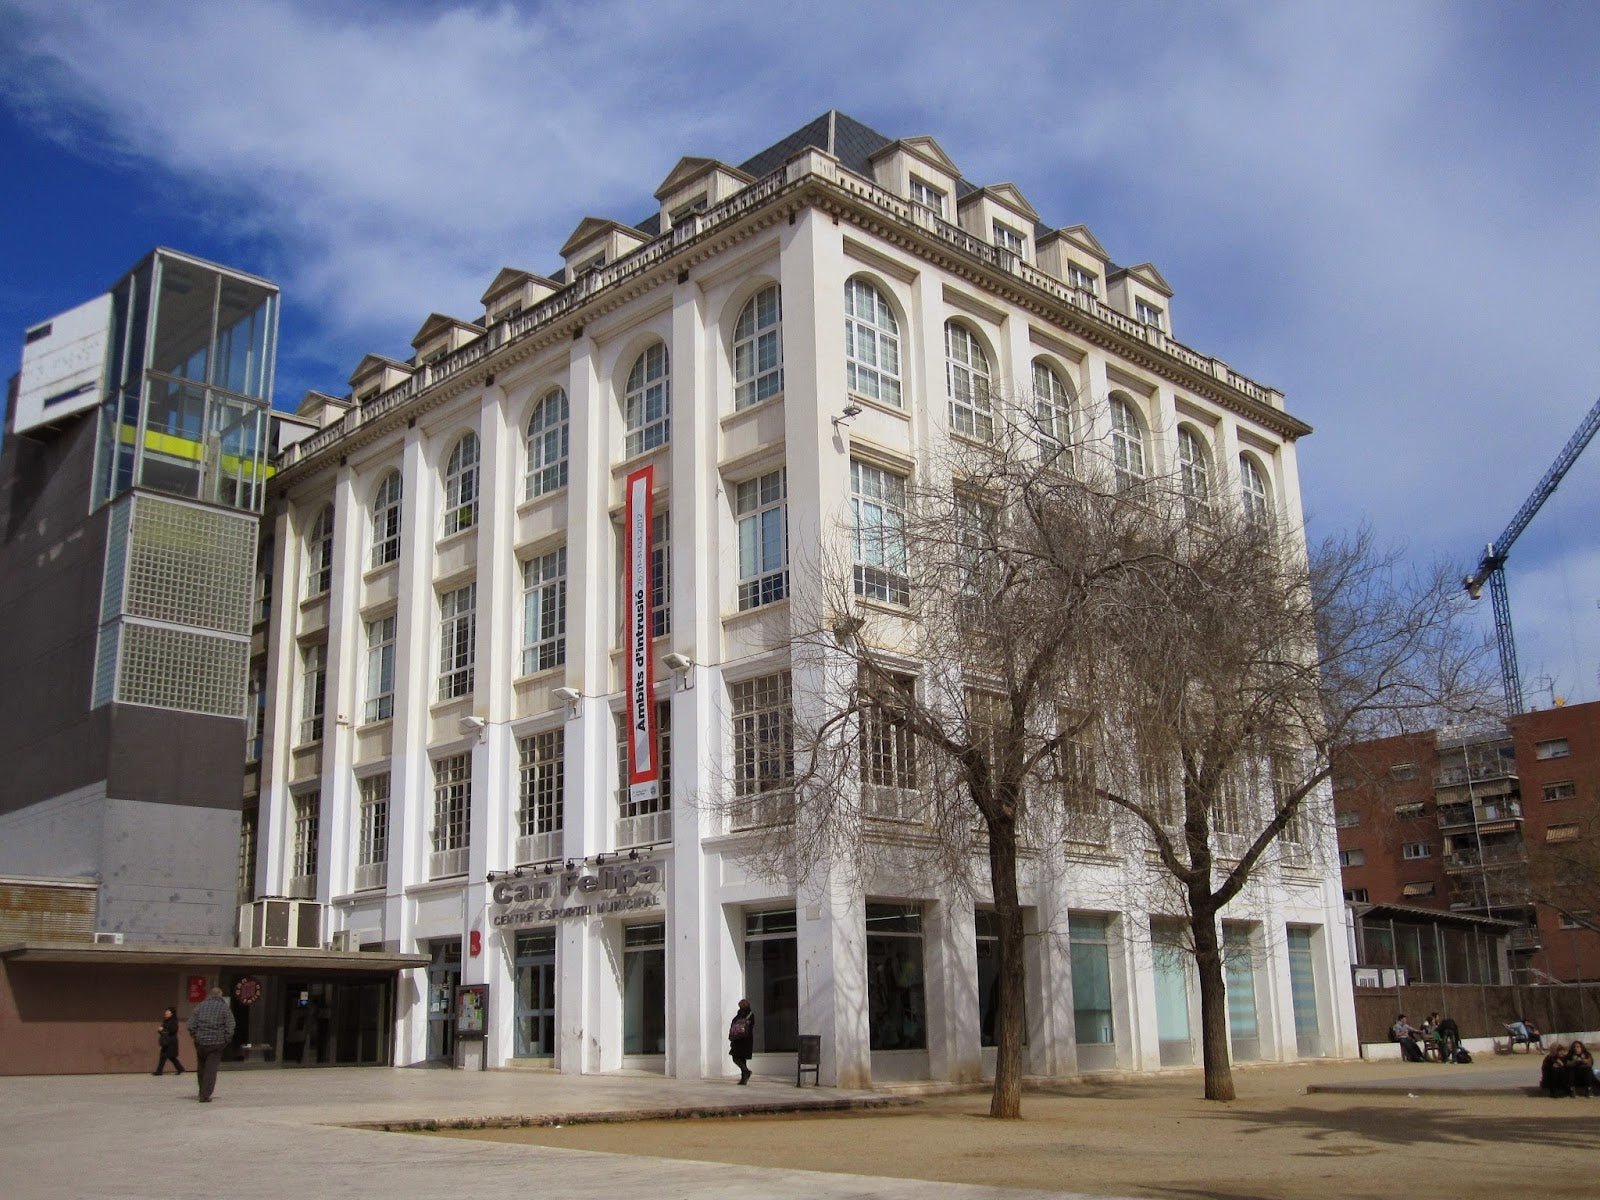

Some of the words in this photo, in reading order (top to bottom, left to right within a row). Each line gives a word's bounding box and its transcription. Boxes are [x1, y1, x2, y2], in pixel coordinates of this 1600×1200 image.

[635, 670, 646, 731] Àmbits
[493, 881, 549, 904] Can
[494, 911, 534, 926] CENTRE
[597, 895, 660, 913] MUNICIPAL
